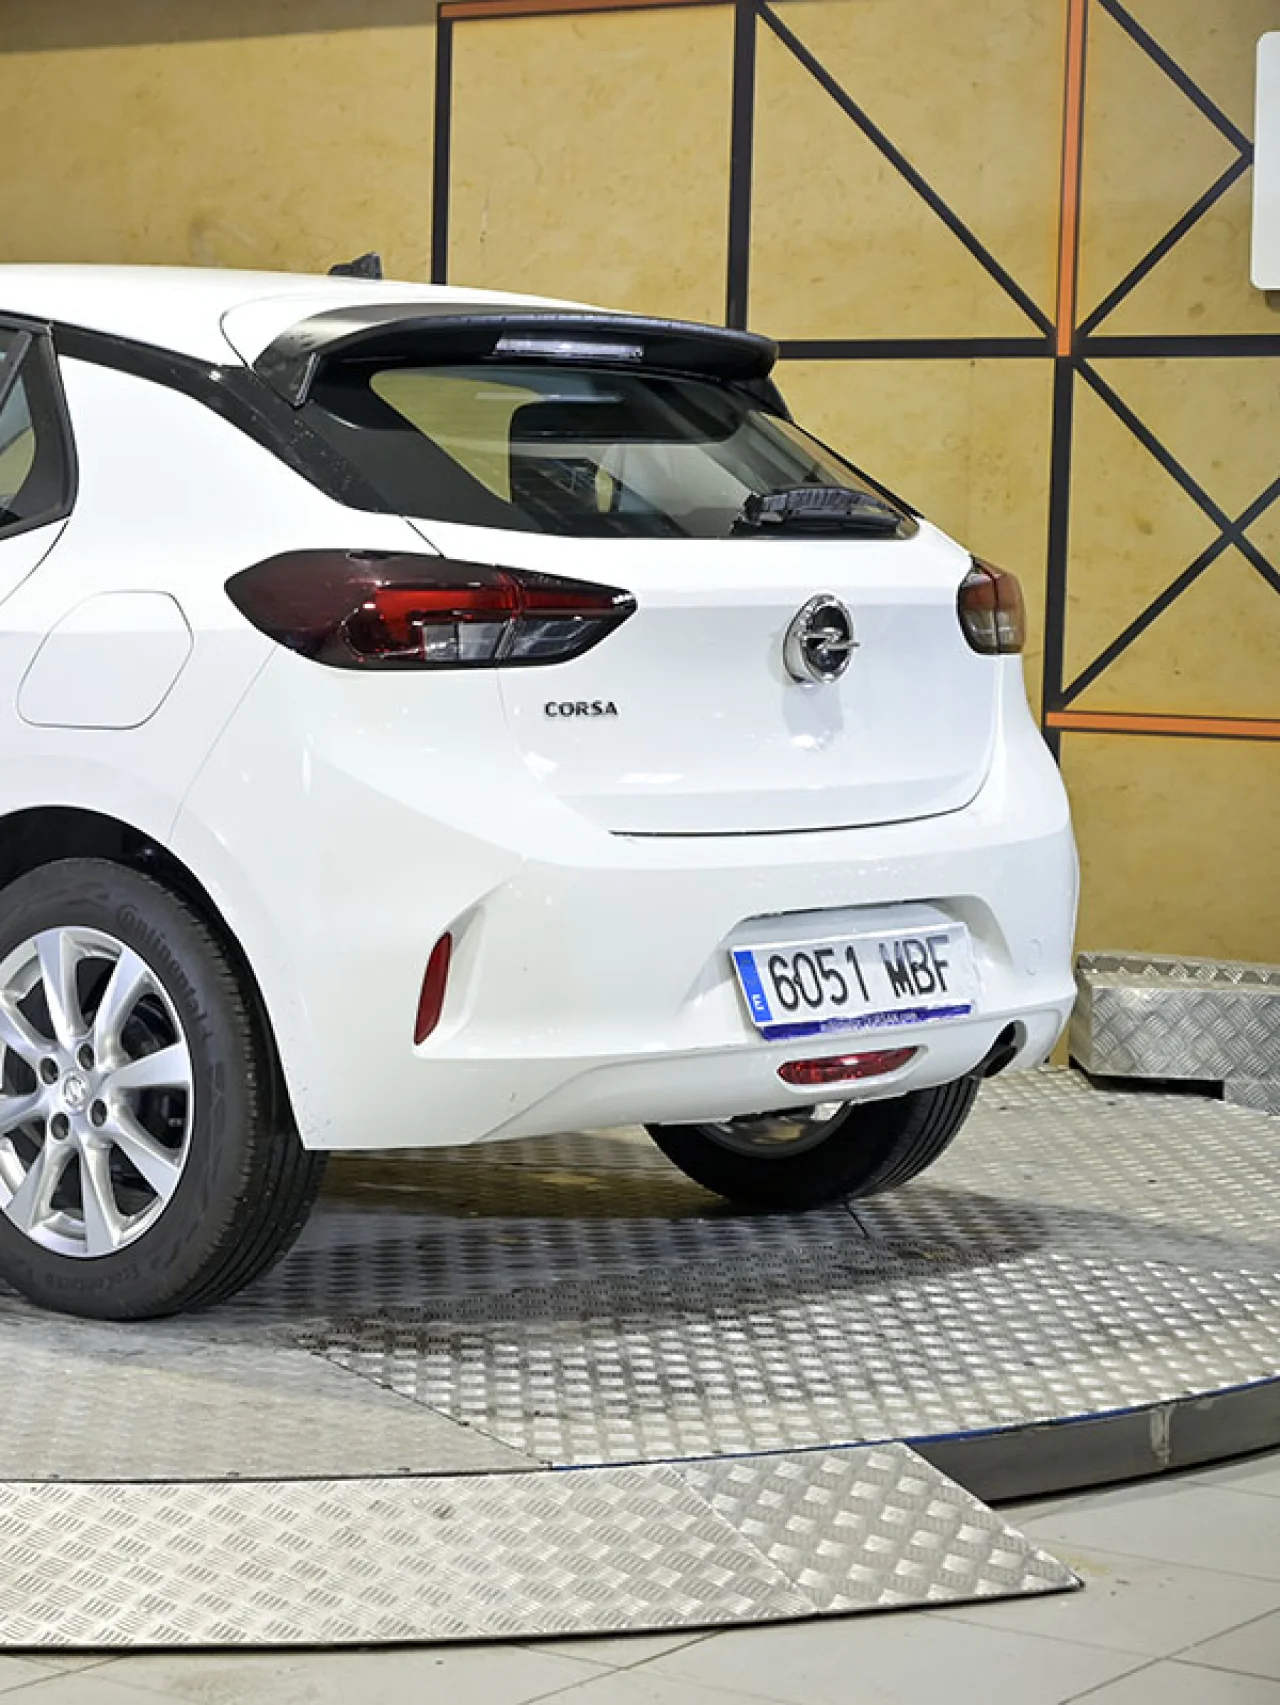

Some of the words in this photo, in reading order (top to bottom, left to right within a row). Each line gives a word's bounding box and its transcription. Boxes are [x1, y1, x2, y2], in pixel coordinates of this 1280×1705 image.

[545, 701, 618, 717] CORSA
[768, 945, 870, 1011] 6051
[878, 935, 950, 998] MBF
[751, 993, 764, 1010] E
